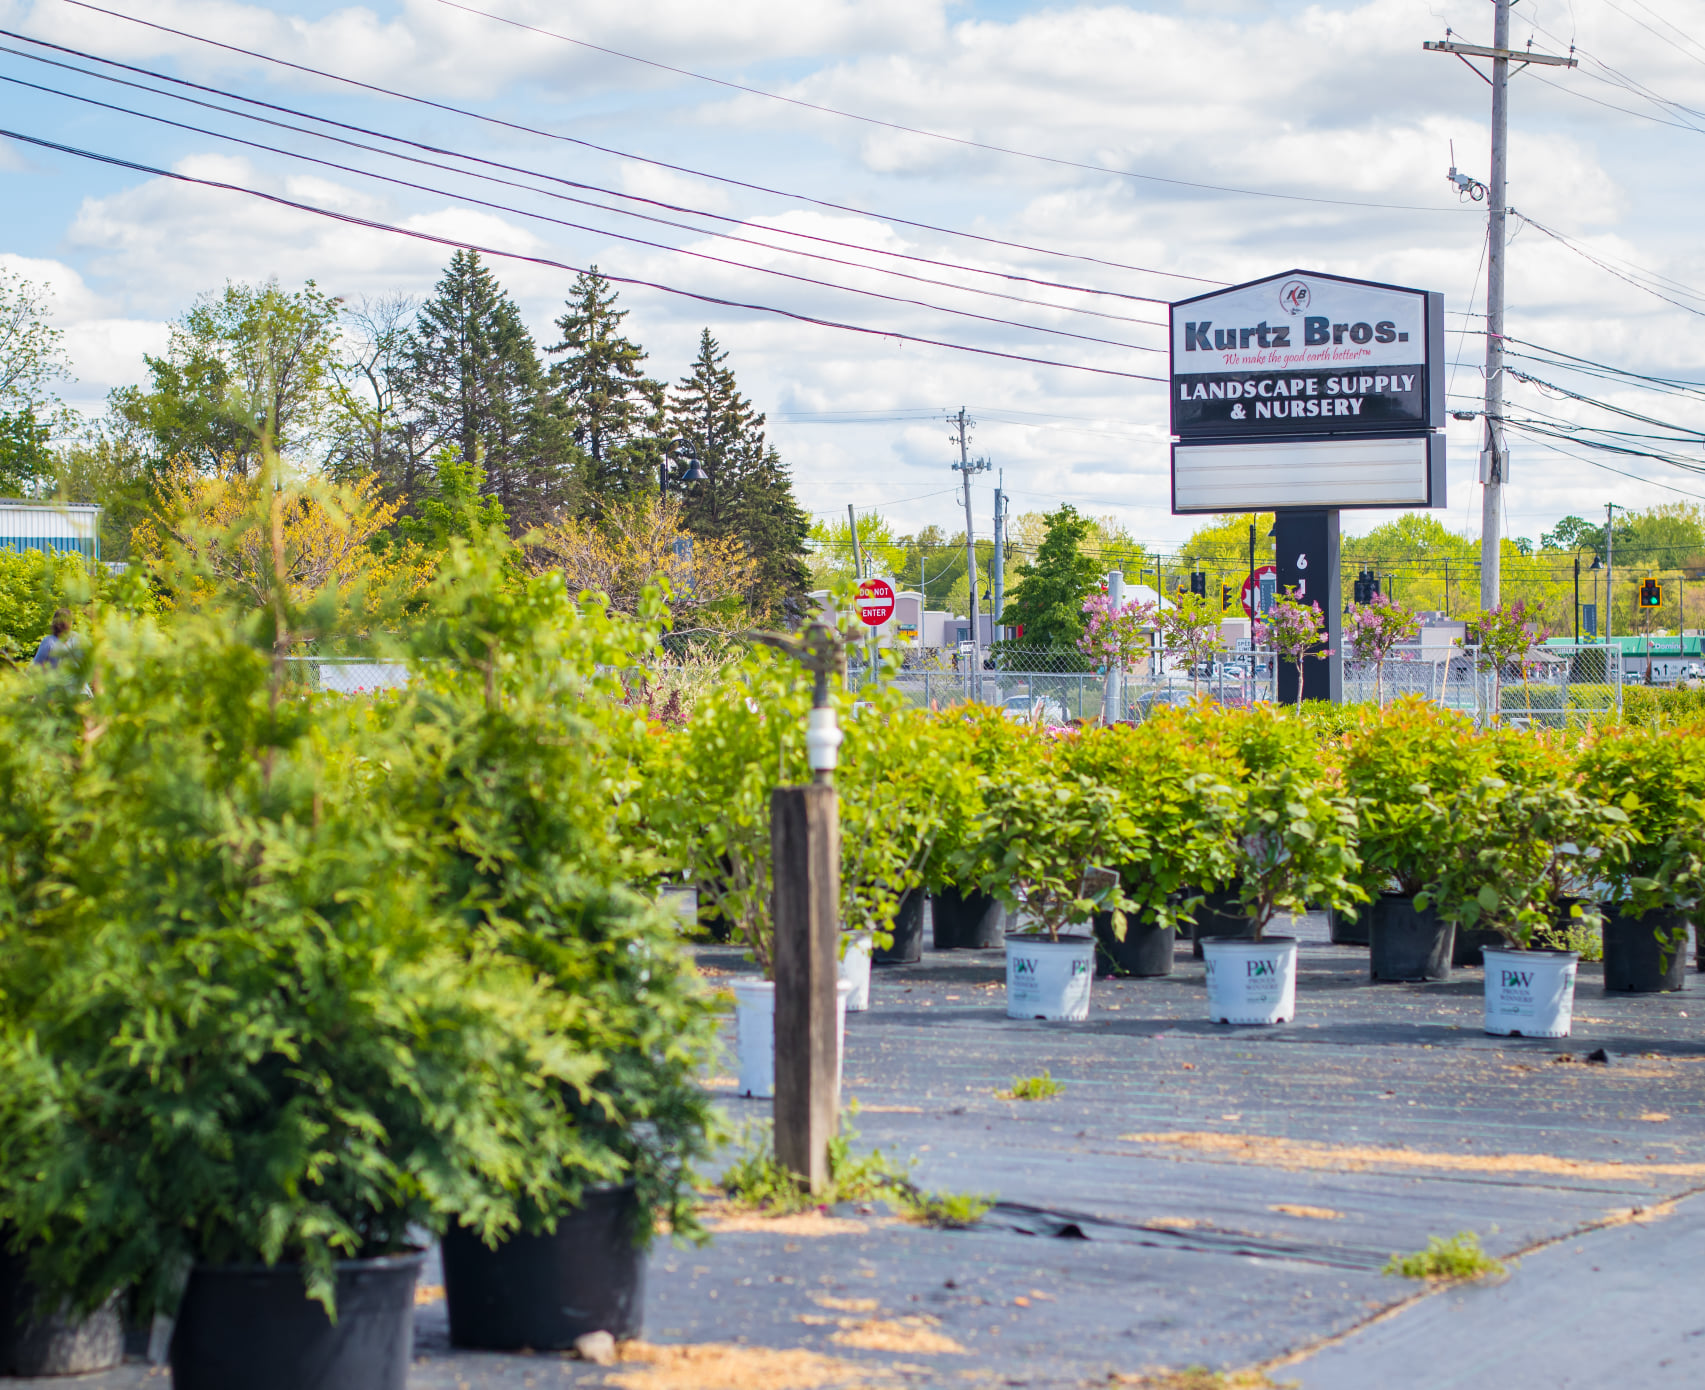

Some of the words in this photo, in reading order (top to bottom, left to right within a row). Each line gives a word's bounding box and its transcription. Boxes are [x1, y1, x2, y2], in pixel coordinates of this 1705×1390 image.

[1185, 320, 1291, 352] Kurtz
[1304, 316, 1409, 346] Bros.
[1222, 353, 1240, 365] We
[1242, 350, 1266, 365] make
[1268, 349, 1281, 363] the
[1281, 348, 1305, 369] good
[1306, 347, 1330, 361] earth
[1180, 378, 1319, 401] LANDSCAPE
[1326, 374, 1415, 395] SUPPLY
[1230, 403, 1247, 420] &
[1255, 398, 1364, 419] NURSERY
[860, 588, 870, 596] DO
[874, 587, 889, 596] NOT
[862, 608, 886, 617] ENTER
